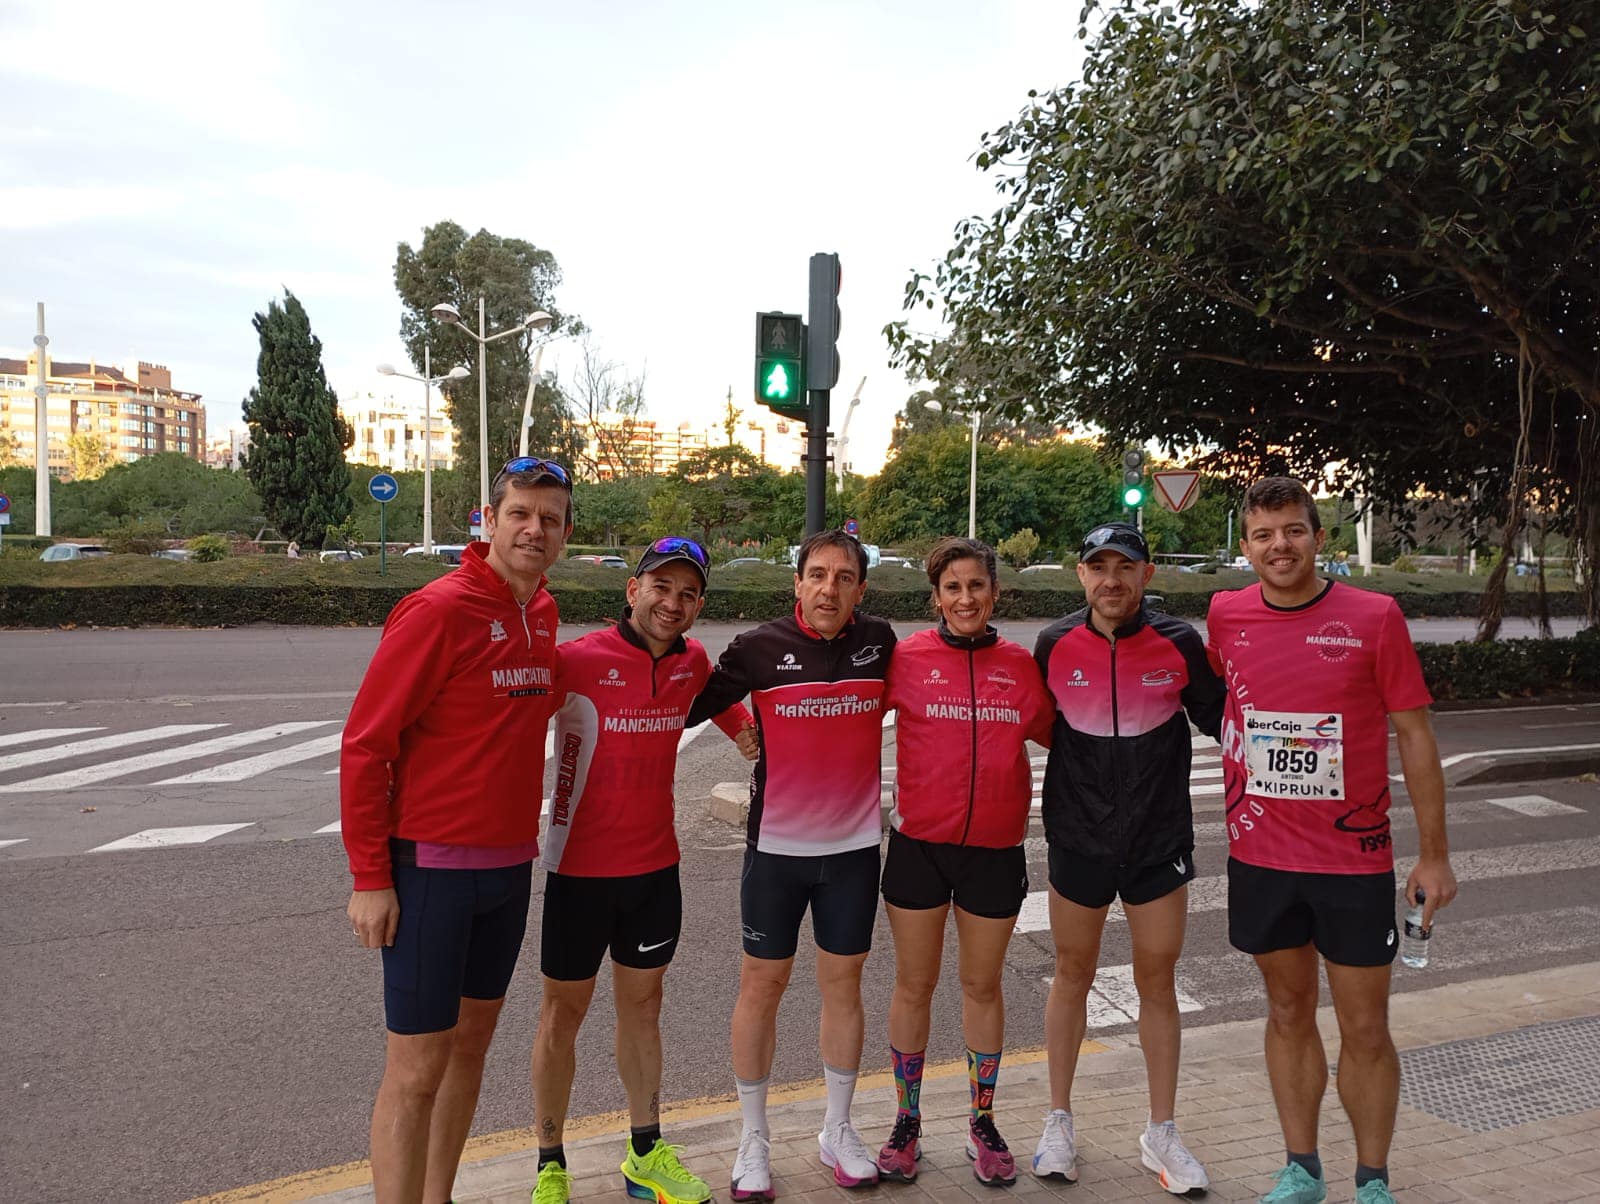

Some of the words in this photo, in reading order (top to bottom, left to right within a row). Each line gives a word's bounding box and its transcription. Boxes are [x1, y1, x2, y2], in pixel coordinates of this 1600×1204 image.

[1305, 635, 1363, 648] MANCHATHON
[599, 679, 626, 687] VIATOR
[841, 693, 859, 703] club
[775, 697, 880, 718] MANCHATHON
[926, 703, 1021, 725] MANCHATHON
[604, 714, 686, 734] MANCHATHON
[1267, 749, 1318, 774] 1859
[1329, 769, 1336, 780] 4
[1264, 781, 1324, 796] KIPRUN
